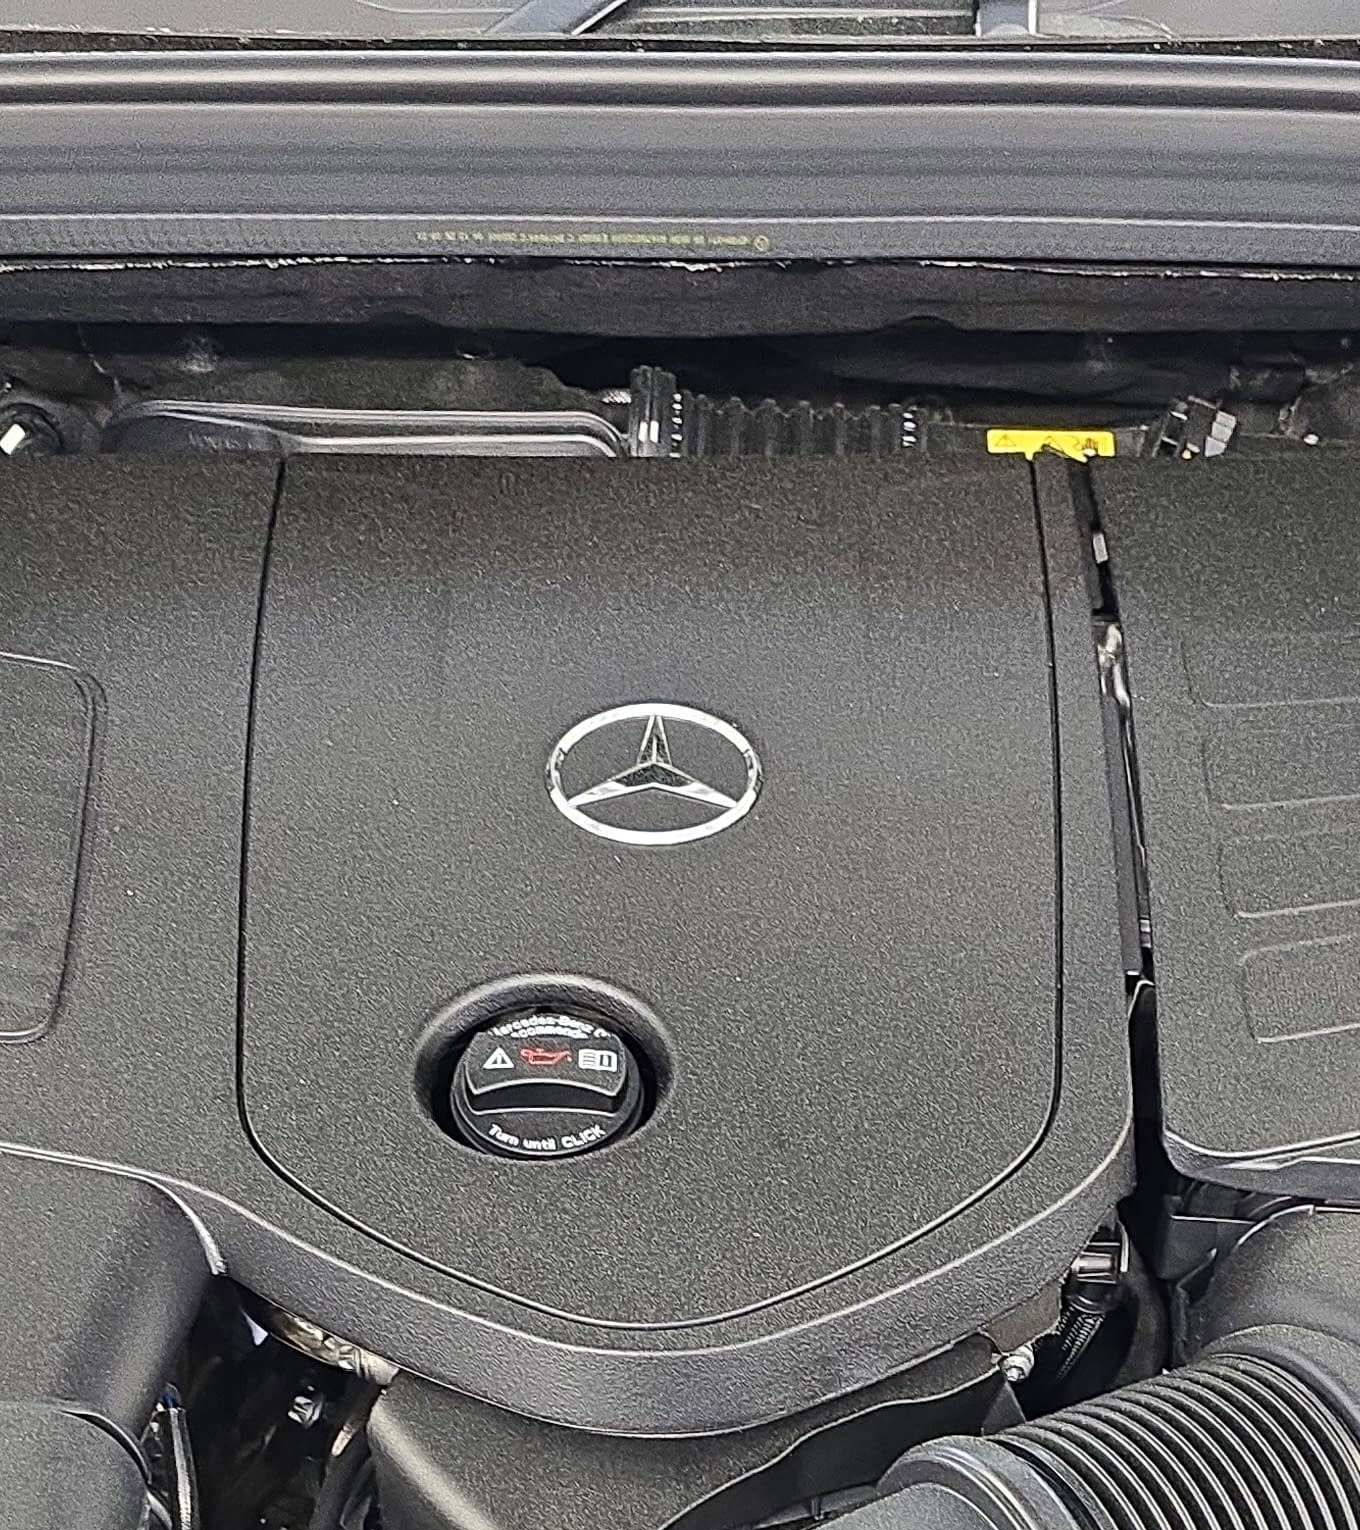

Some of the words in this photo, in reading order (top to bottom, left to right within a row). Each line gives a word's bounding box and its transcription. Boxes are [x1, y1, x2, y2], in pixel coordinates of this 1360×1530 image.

[488, 1124, 519, 1146] Turn
[523, 1137, 556, 1150] until
[561, 1124, 606, 1148] CLICK
